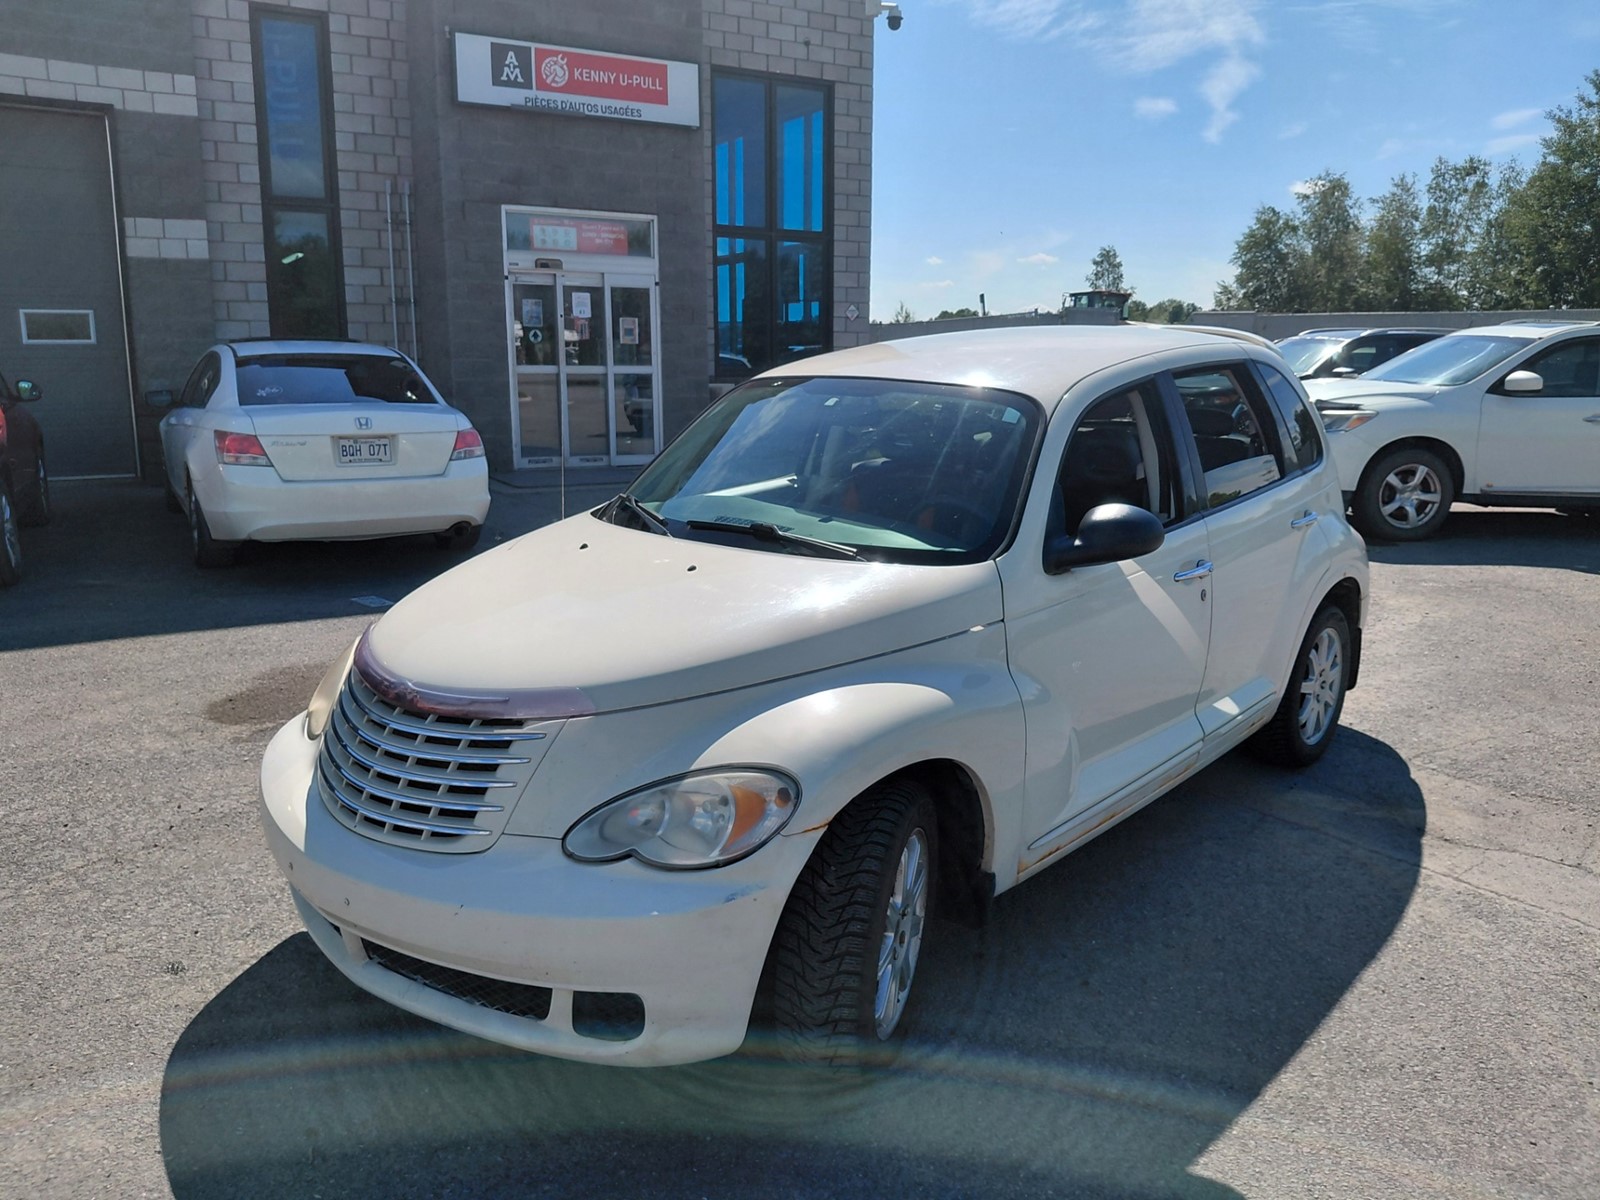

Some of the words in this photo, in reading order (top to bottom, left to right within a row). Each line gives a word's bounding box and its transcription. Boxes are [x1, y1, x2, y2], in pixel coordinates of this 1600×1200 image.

[574, 67, 617, 85] KENNY
[619, 73, 663, 90] U-PULL
[524, 95, 559, 110] PIÈCES
[560, 100, 599, 114] D'AUTOS
[600, 105, 642, 118] USAGÉES
[341, 444, 362, 457] BQH
[368, 443, 388, 457] 07T
